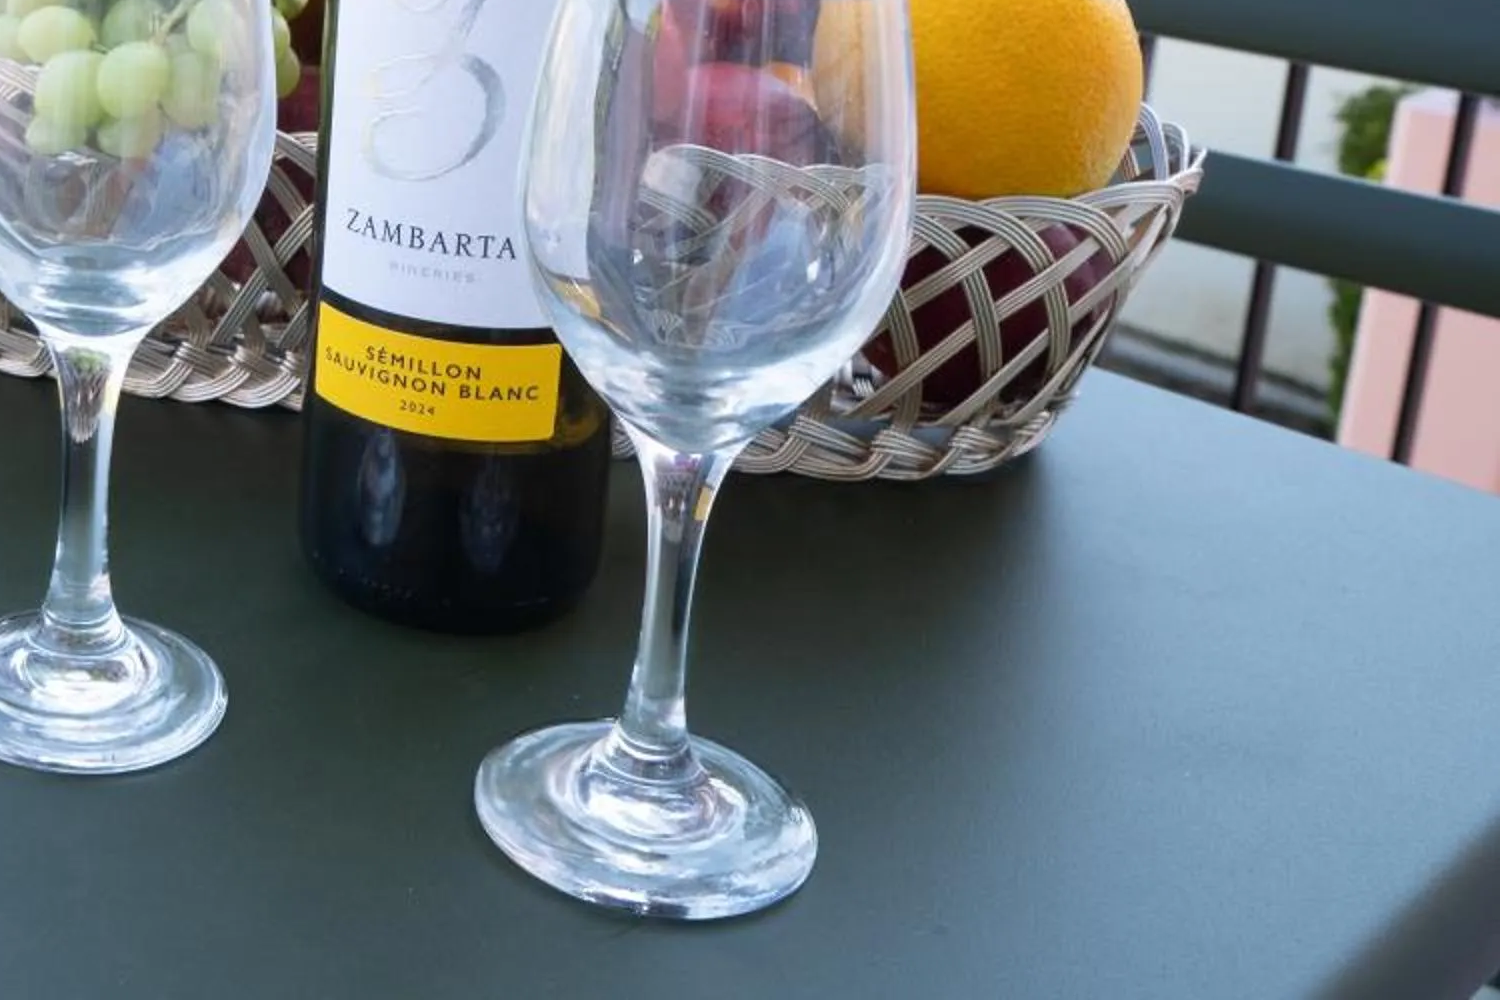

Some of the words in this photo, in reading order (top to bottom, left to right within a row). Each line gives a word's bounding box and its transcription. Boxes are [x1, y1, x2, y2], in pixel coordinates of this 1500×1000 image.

[346, 208, 517, 260] ZAMBARTA
[325, 344, 446, 397] SAUVIGNON
[459, 383, 540, 401] BLANC
[365, 344, 482, 381] SÉMILLON
[399, 398, 436, 416] 2024
